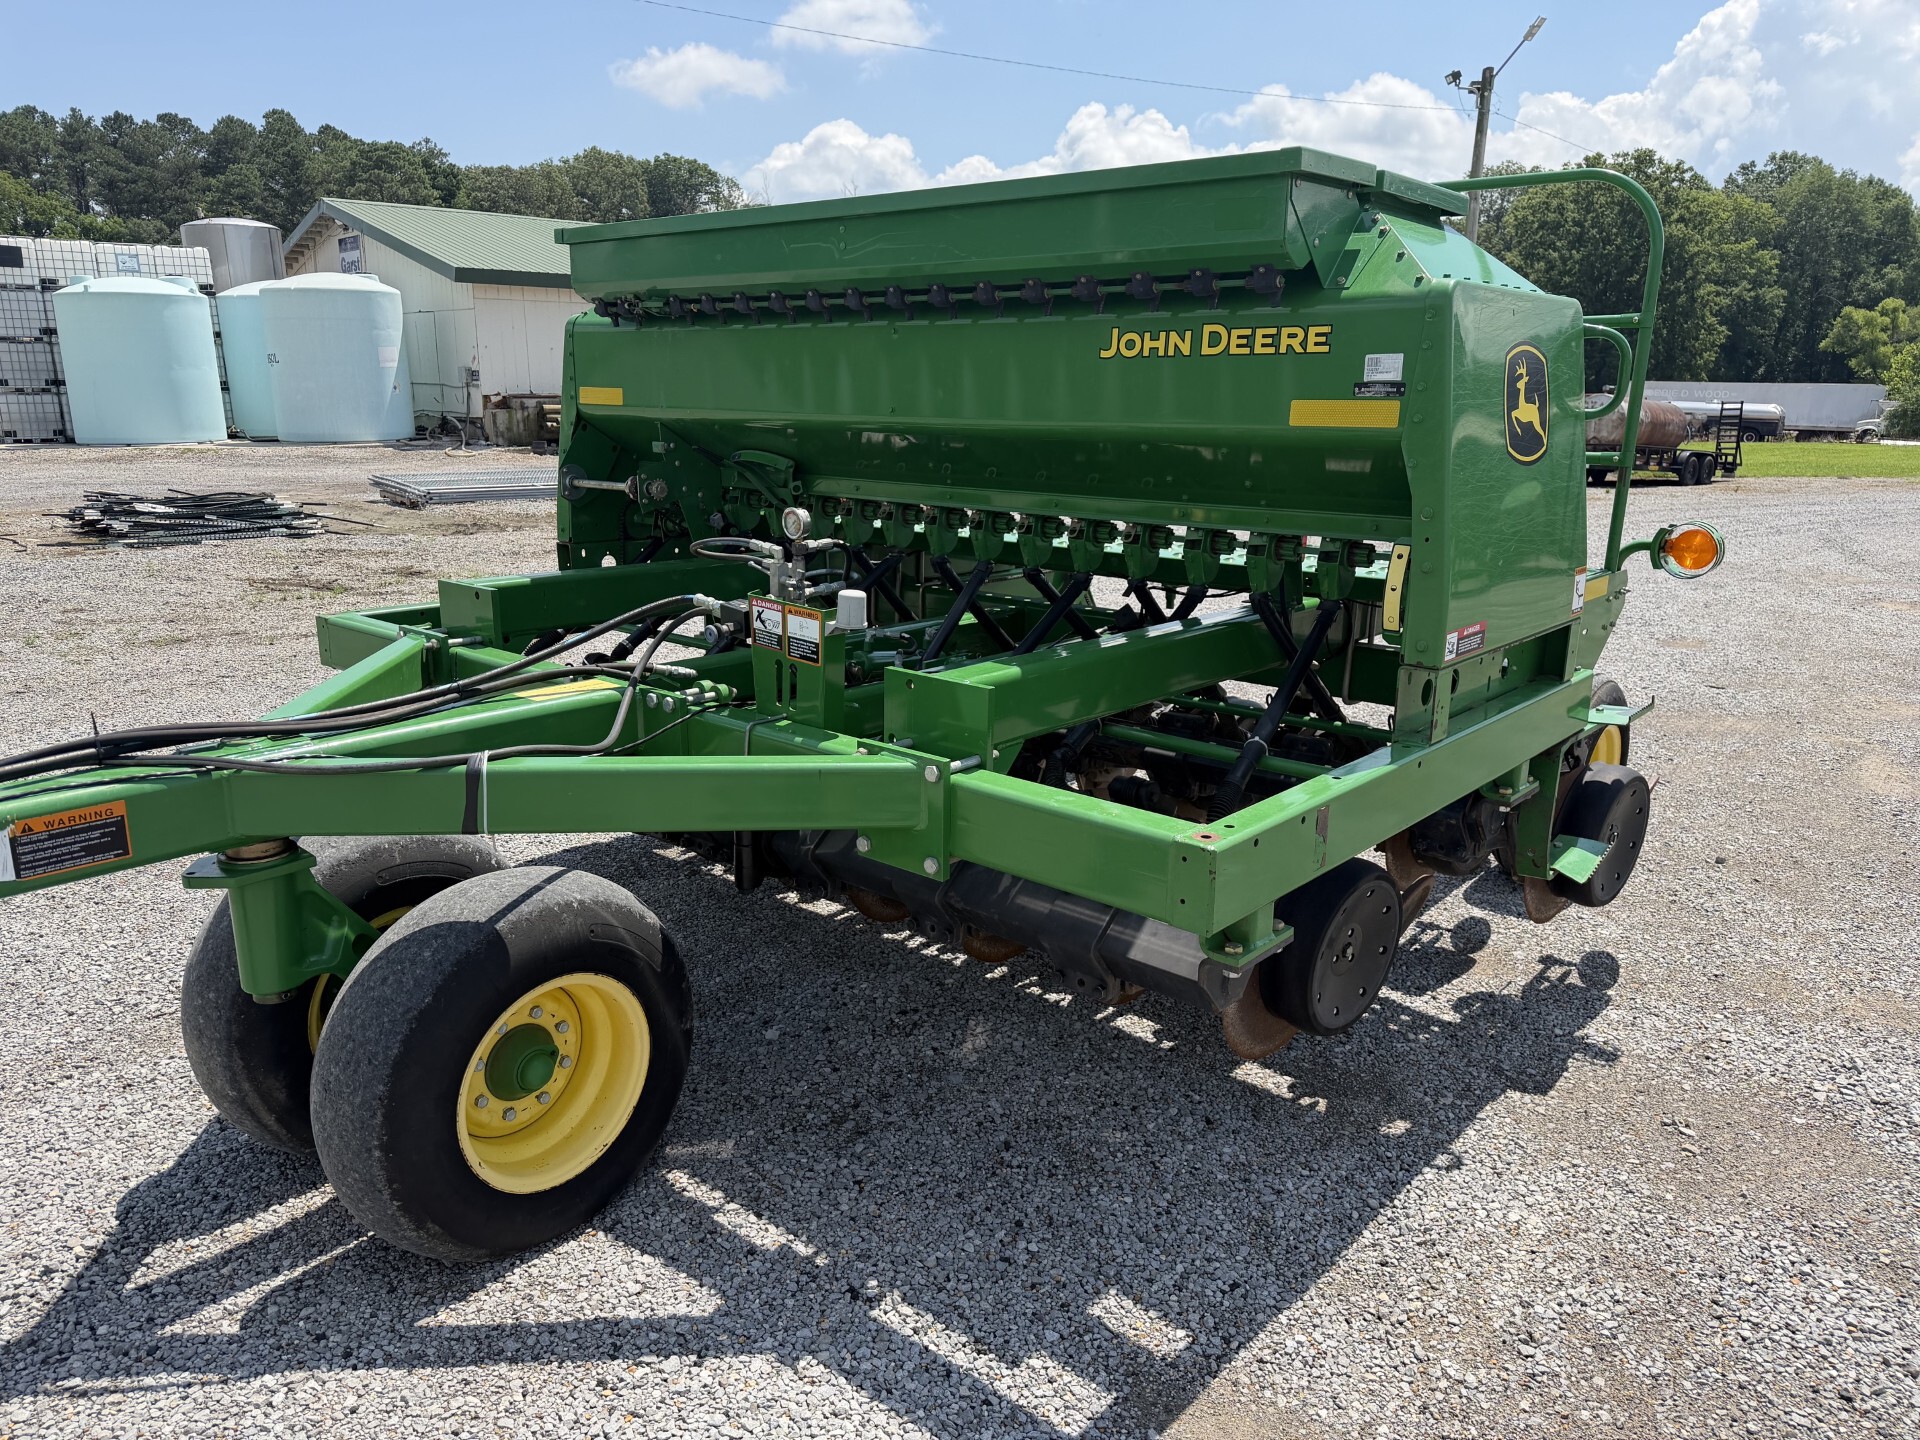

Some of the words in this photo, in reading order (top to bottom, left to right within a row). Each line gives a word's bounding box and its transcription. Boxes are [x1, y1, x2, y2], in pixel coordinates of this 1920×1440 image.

[341, 256, 360, 273] Garst
[1099, 326, 1193, 359] JOHN
[1200, 323, 1333, 356] DEERE
[1694, 389, 1730, 399] WOOD
[757, 600, 782, 611] DANGER
[793, 608, 819, 620] WARNING
[43, 808, 114, 829] WARNING
